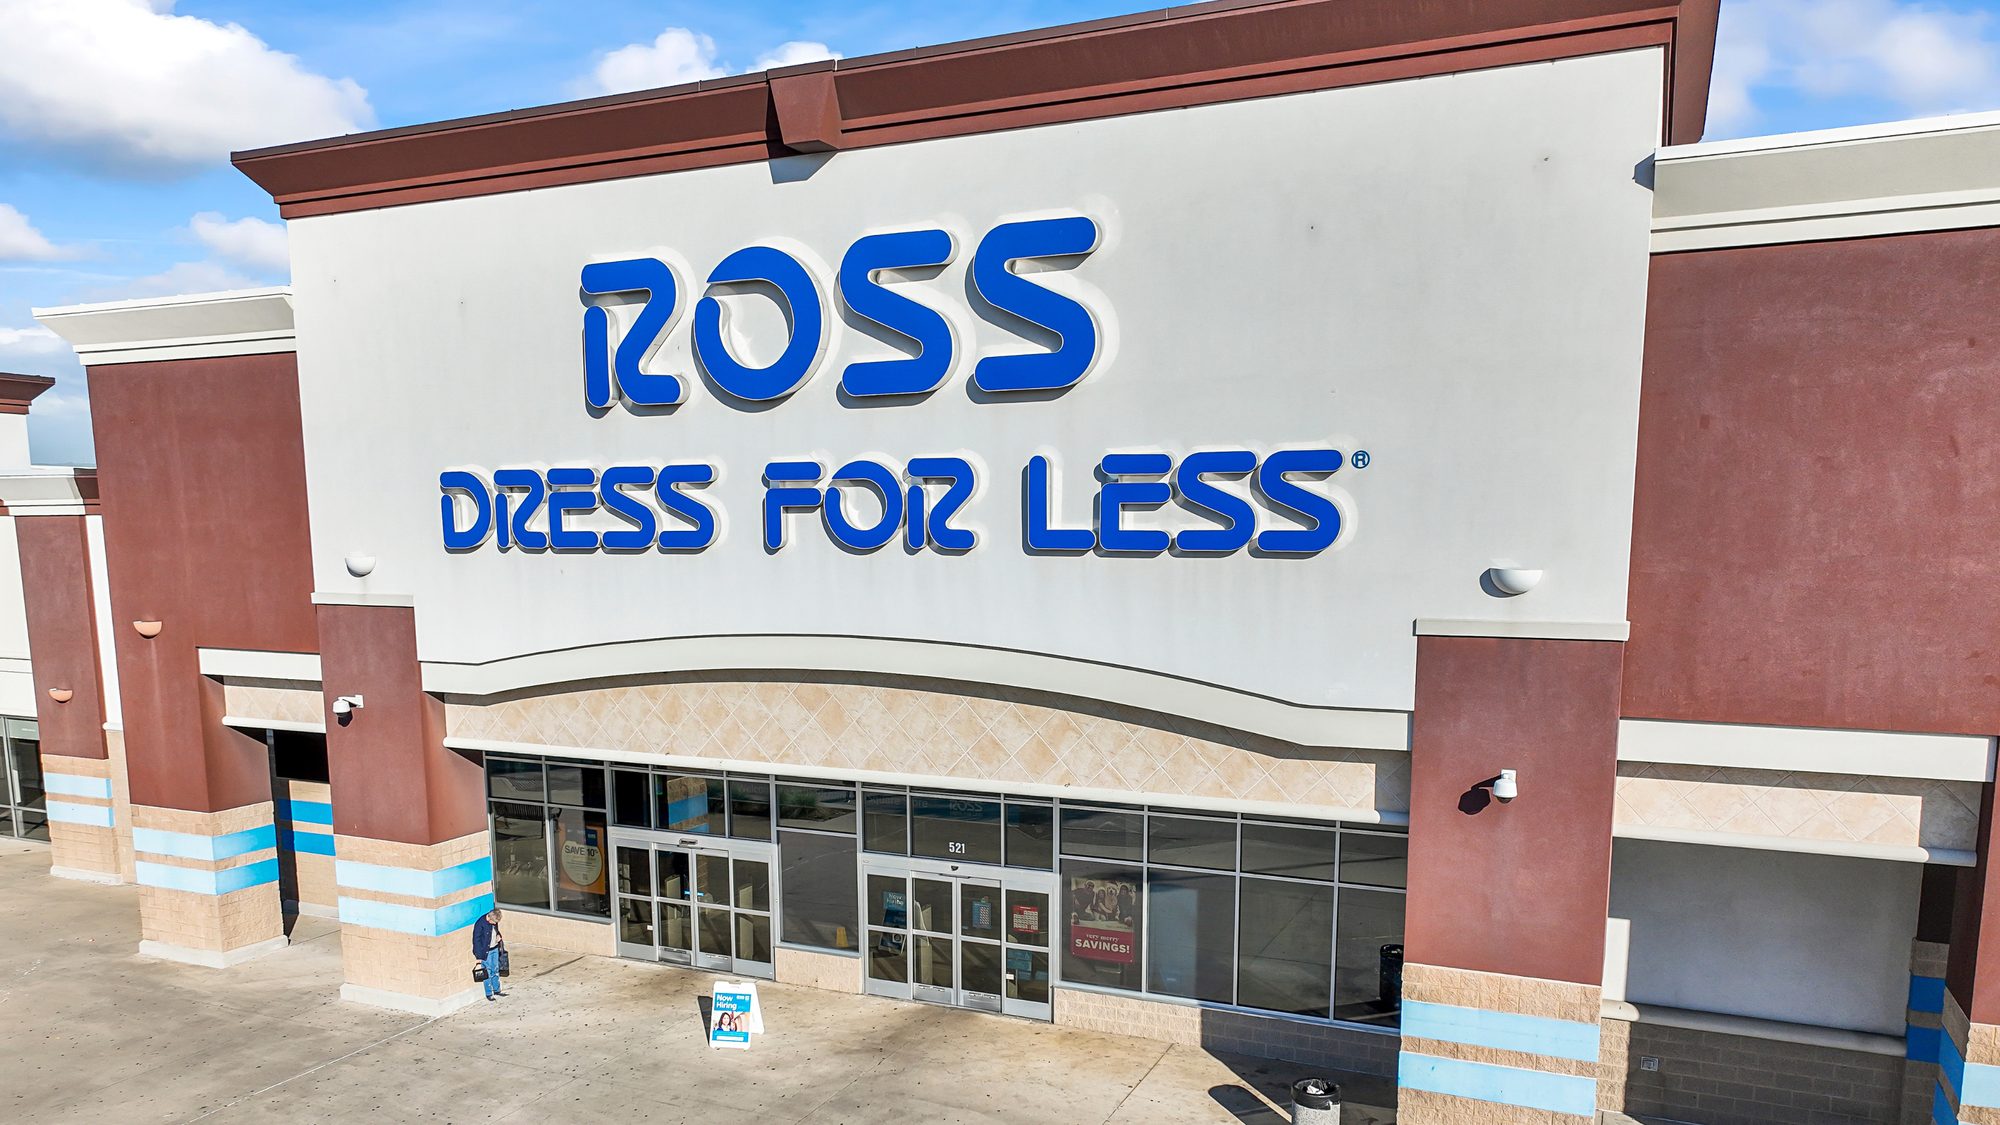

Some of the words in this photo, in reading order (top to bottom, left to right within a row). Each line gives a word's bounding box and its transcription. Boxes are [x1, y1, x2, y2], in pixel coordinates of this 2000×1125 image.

[581, 217, 1096, 409] ROSS
[440, 462, 714, 551] DRESS
[765, 457, 975, 551] FOR
[1028, 449, 1343, 552] LESS
[564, 845, 584, 856] SAVE
[949, 842, 965, 854] 521
[1075, 938, 1130, 954] SAVINGS!
[716, 993, 733, 1002] Now
[716, 1001, 737, 1011] Hiring
